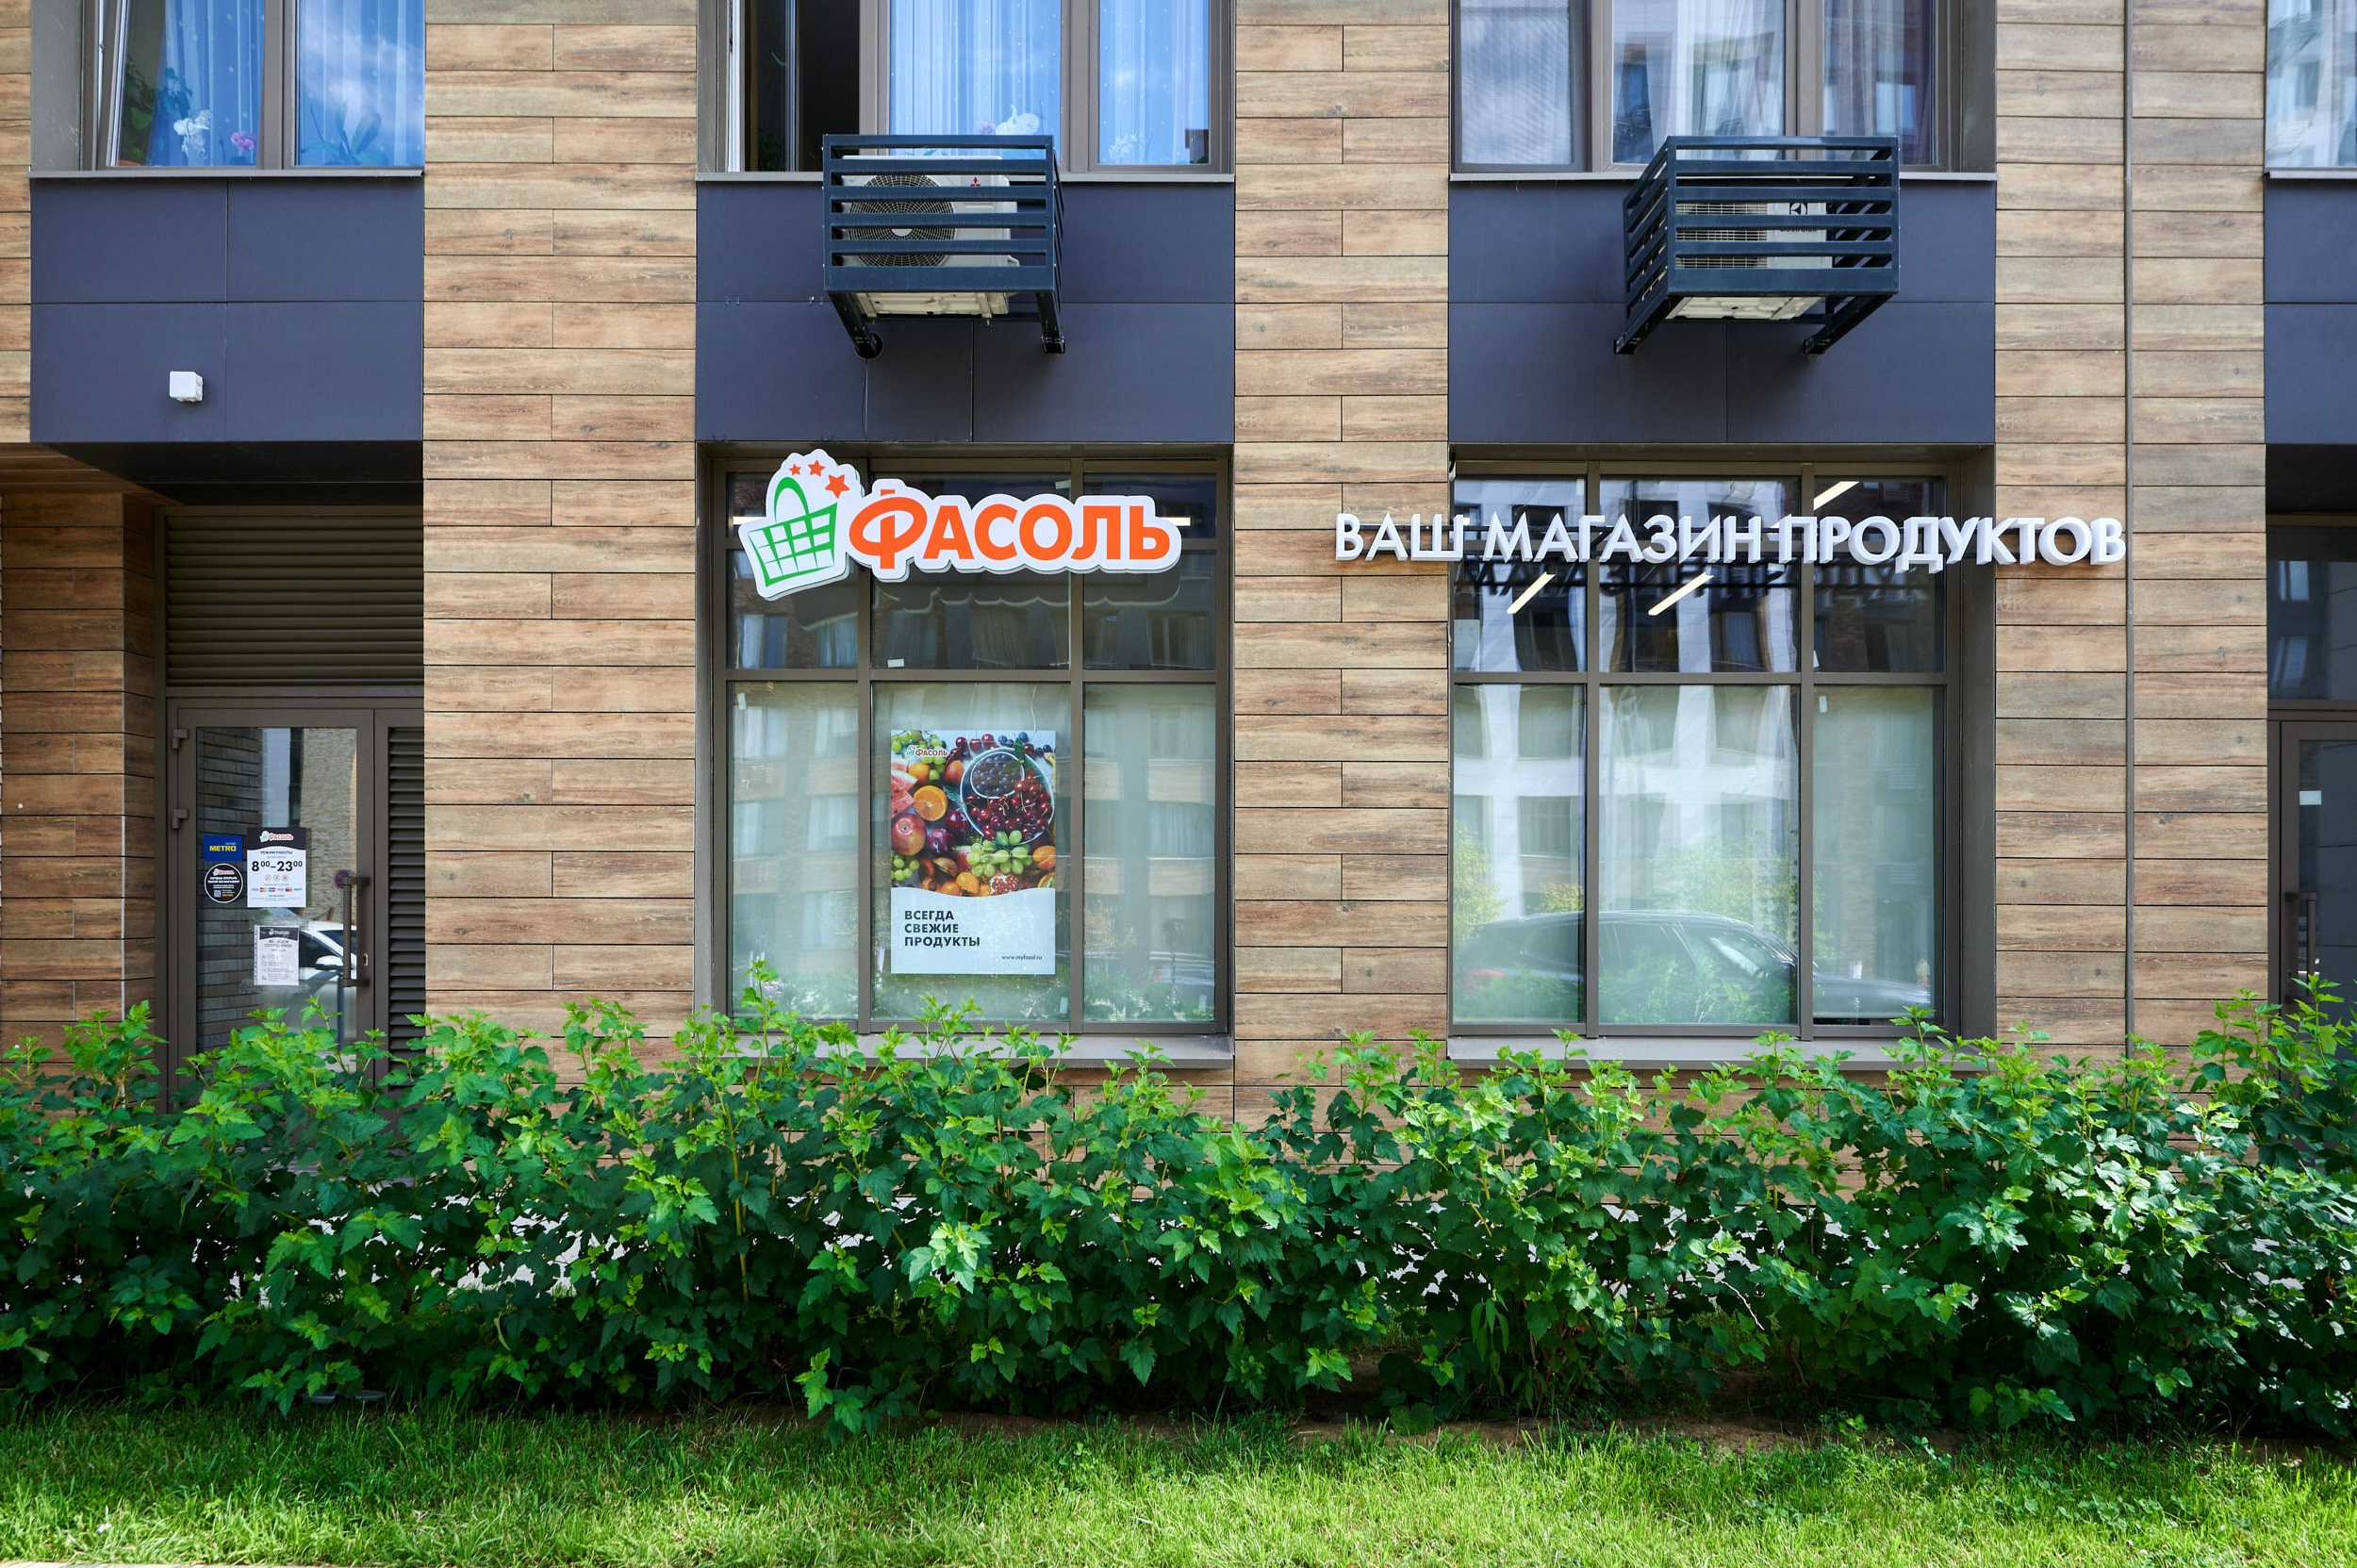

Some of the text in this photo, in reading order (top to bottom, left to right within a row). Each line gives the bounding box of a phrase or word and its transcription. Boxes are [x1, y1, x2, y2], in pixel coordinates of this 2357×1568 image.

[848, 488, 1171, 569] ФАСОЛЬ
[1335, 510, 2127, 574] ВАШ МАГАЗИН ПРОДУКТОВ
[904, 910, 954, 922] ВСЕГДА
[904, 923, 959, 933] СВЕЖИЕ
[904, 936, 981, 949] ПРОДУКТЫ
